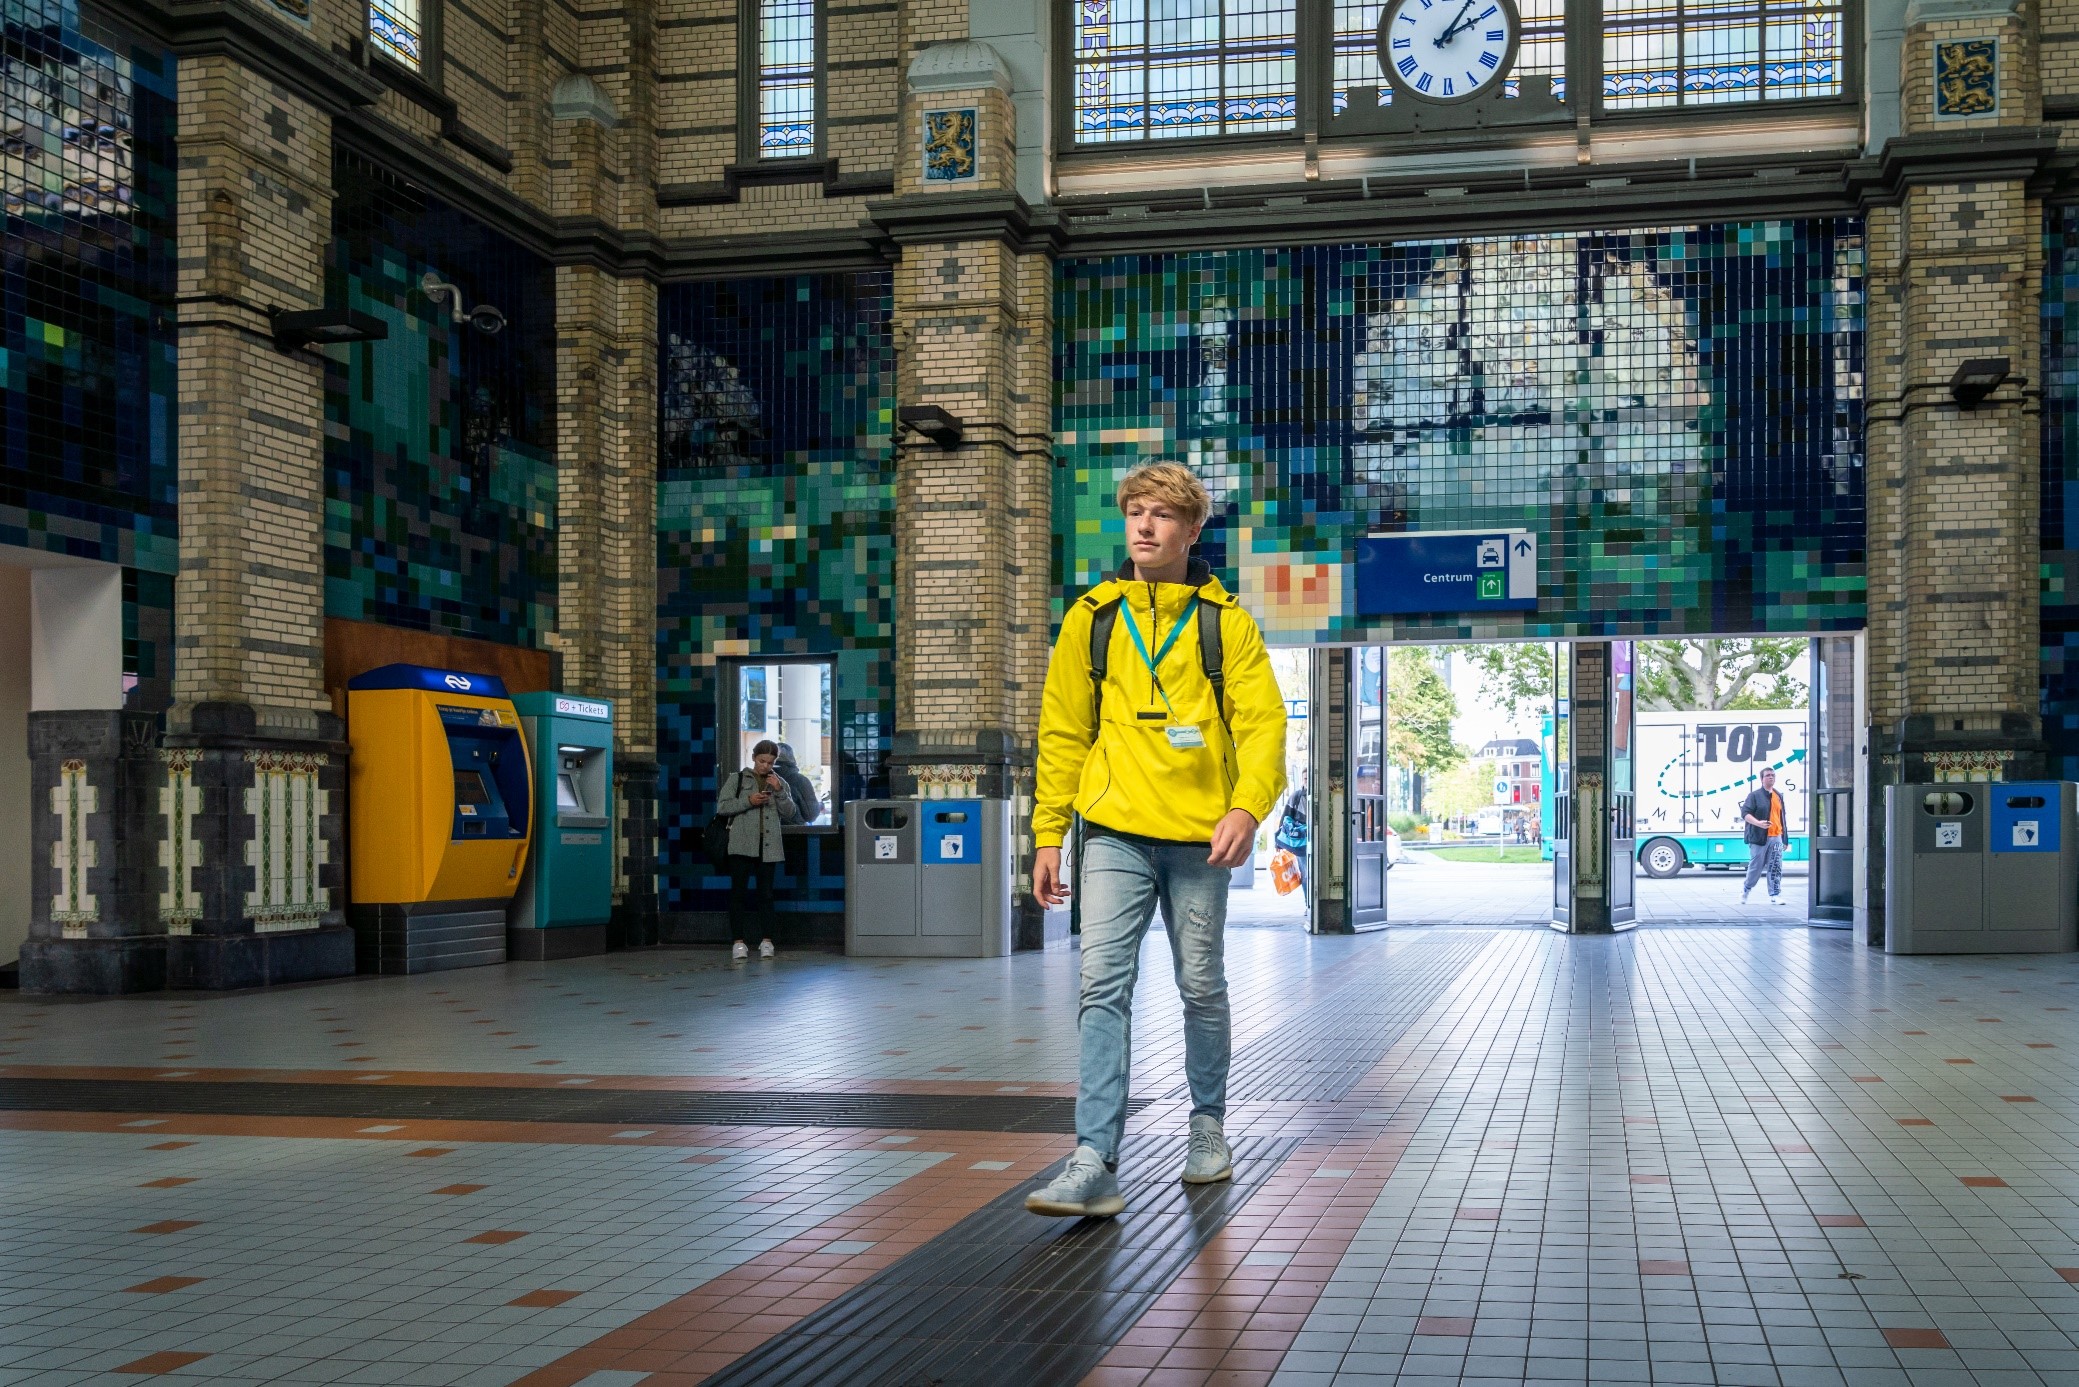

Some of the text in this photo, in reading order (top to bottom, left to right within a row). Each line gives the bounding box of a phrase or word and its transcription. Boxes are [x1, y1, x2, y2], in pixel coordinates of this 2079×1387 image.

[1486, 30, 1503, 41] III
[1423, 573, 1473, 583] Centrum
[578, 703, 604, 715] Tickets
[1696, 725, 1782, 763] TOP
[1652, 779, 1796, 823] MOVS
